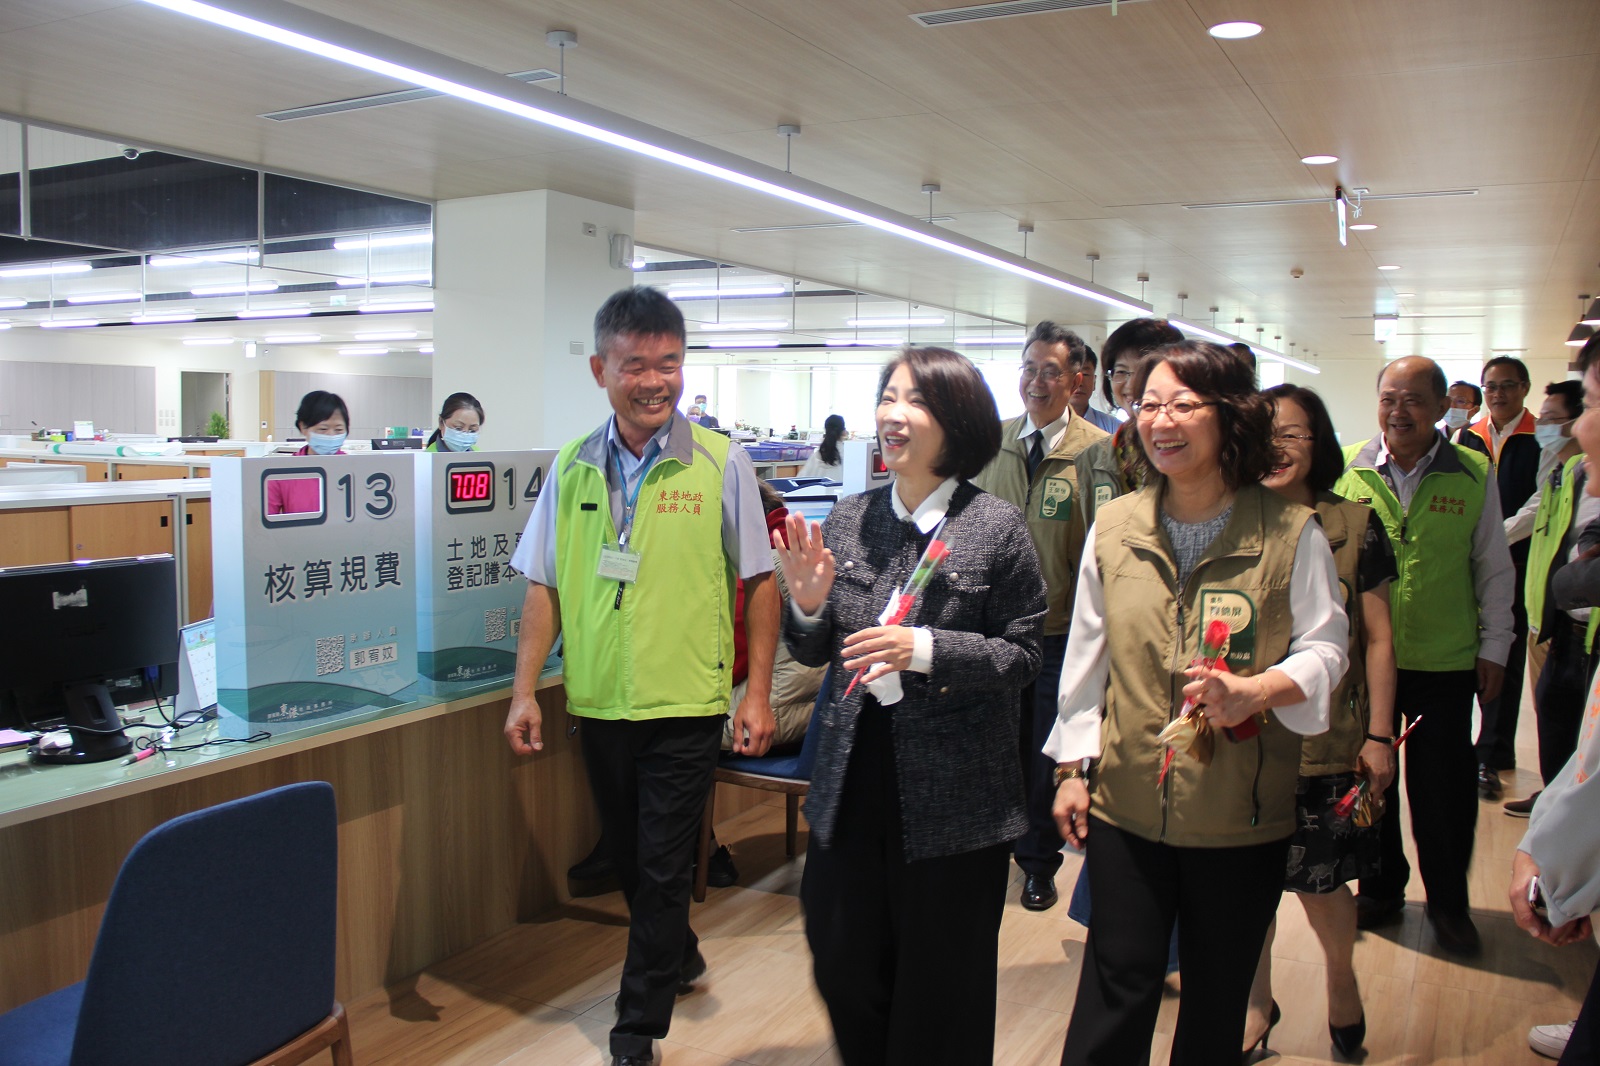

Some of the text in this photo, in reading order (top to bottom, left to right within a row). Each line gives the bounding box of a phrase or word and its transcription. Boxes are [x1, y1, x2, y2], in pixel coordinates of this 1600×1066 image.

[337, 471, 397, 521] 13
[451, 473, 489, 499] 708
[503, 465, 544, 509] 14
[657, 489, 704, 504] 東港地政
[655, 502, 702, 516] 服務人員
[264, 551, 402, 605] 核算規費
[446, 561, 529, 591] 登記謄本
